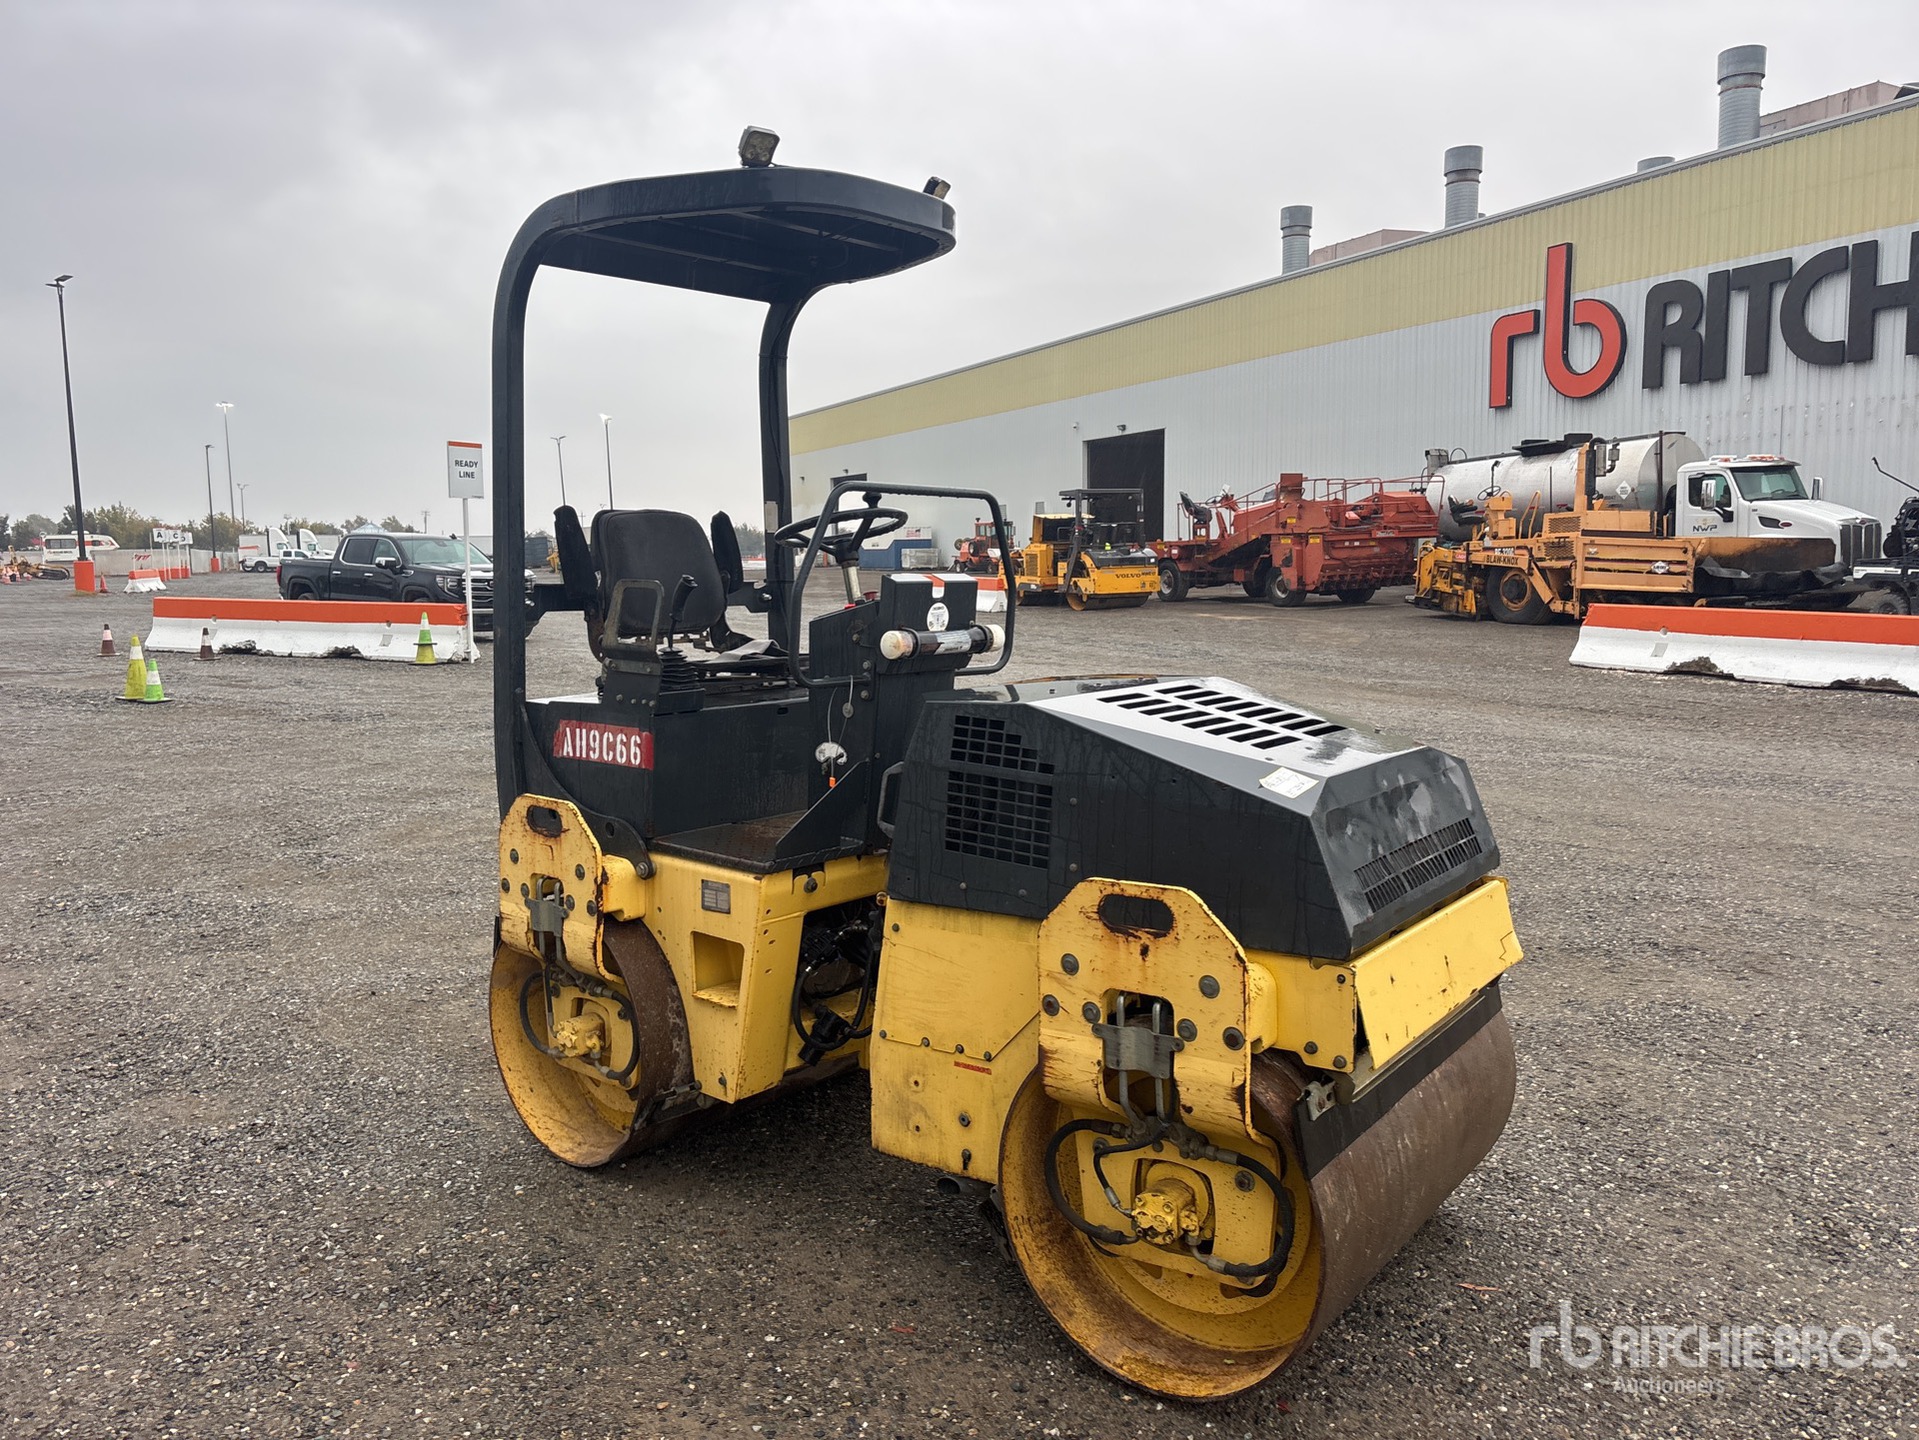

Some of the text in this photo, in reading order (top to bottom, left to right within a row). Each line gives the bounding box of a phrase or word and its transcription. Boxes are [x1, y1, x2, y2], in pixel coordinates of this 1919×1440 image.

[1489, 242, 1627, 409] rb
[454, 459, 479, 468] READY
[458, 470, 476, 479] LINE
[1692, 524, 1718, 532] NWP
[156, 531, 163, 539] A
[1485, 554, 1519, 566] BLAW-KNOX
[563, 727, 641, 766] AH9C66
